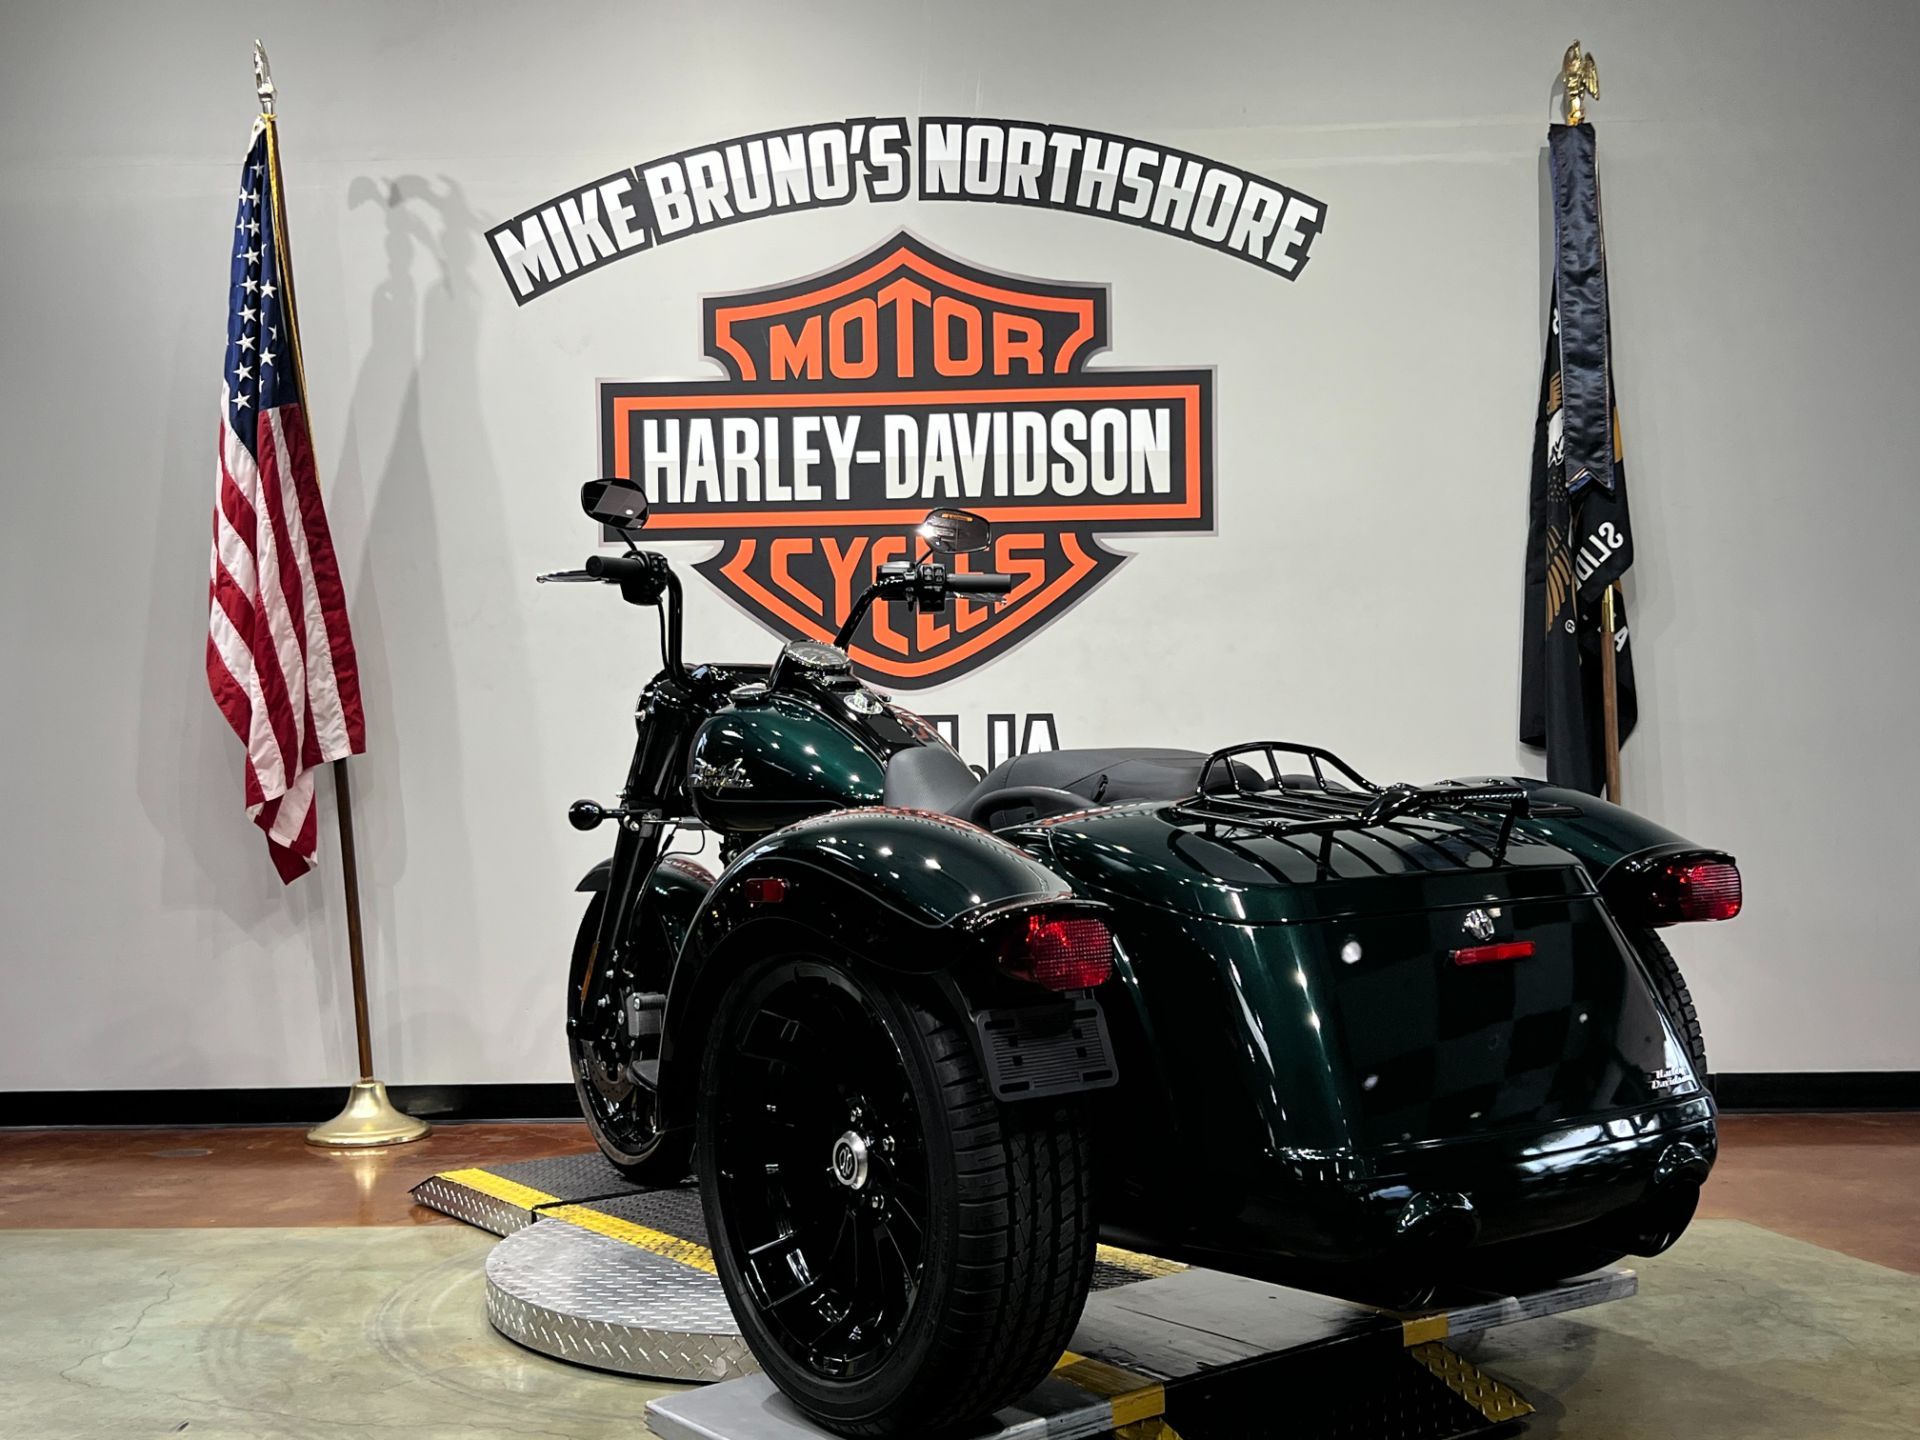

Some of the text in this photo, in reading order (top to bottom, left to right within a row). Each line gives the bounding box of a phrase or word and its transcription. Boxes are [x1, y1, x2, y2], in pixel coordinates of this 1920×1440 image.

[491, 122, 1320, 298] MIKE BRUNO'S NORTHSHORE
[769, 276, 1045, 381] MOTOR
[642, 407, 1171, 505] HARLEY-DAVIDSON
